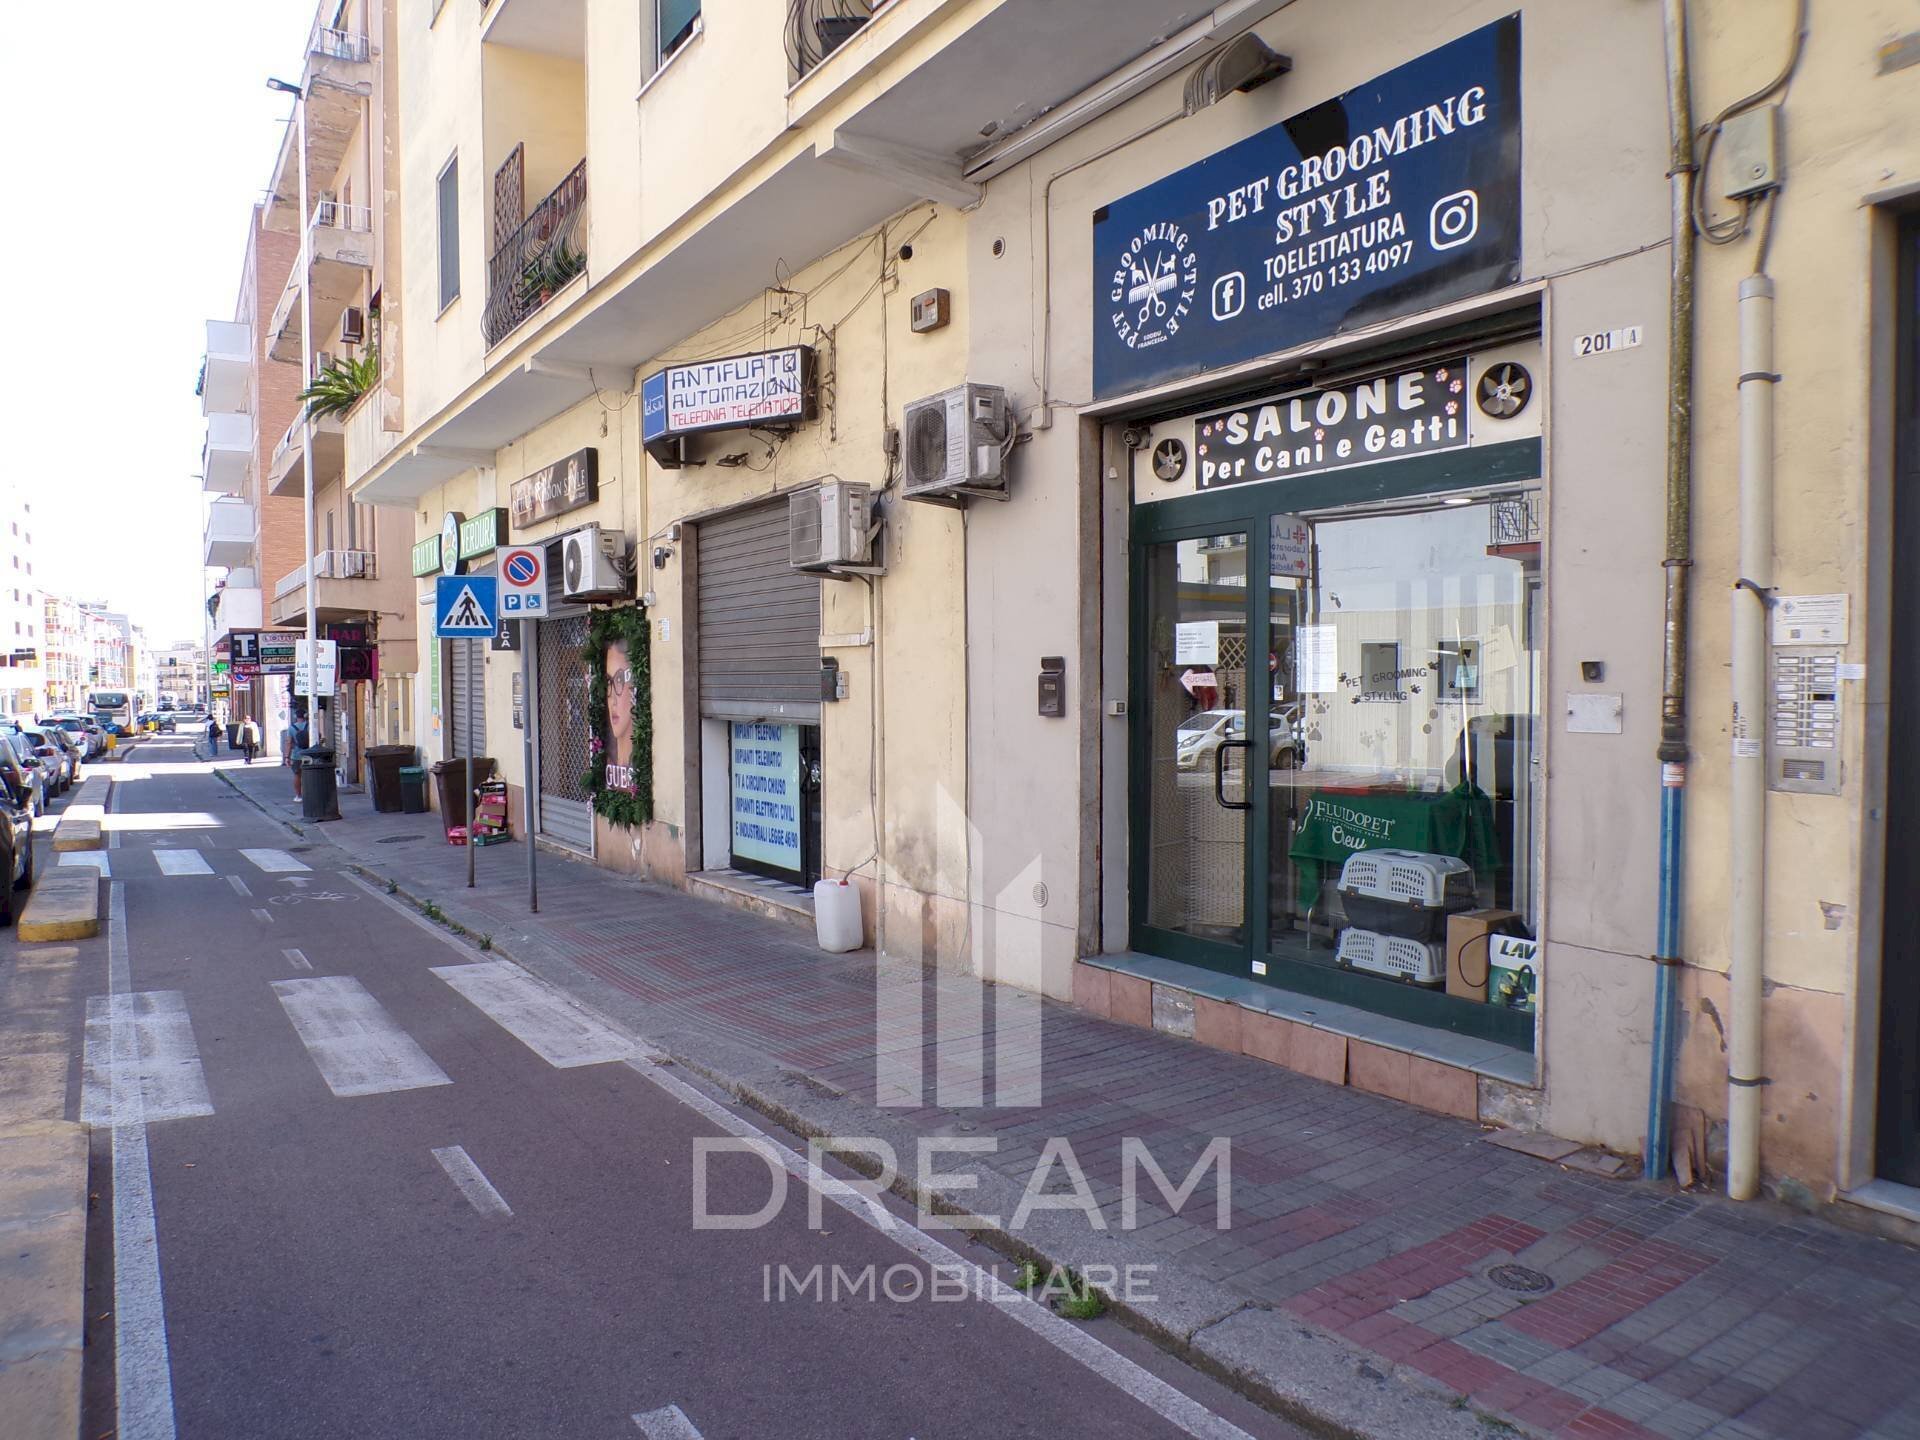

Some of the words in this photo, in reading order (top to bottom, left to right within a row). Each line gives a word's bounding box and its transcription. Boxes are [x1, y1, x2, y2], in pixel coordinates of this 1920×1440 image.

[1207, 177, 1269, 231] PET
[1276, 86, 1486, 201] GROOMING
[1275, 170, 1391, 244] STYLE
[1264, 212, 1405, 282] TOELETTATURA
[1111, 222, 1188, 302] GROOMING
[1258, 281, 1288, 310] cell.
[1292, 271, 1323, 300] 370
[1328, 264, 1360, 289] 133
[1365, 240, 1413, 274] 4097
[1166, 252, 1197, 335] STYLE
[1112, 310, 1139, 348] PET
[1137, 335, 1168, 349] FRANCESCA
[1582, 332, 1611, 355] 201
[1629, 329, 1637, 344] A
[672, 352, 796, 390] ANTIFURTO
[672, 378, 797, 410] AUTOMAZIONI
[1226, 372, 1425, 445] SALONE
[672, 407, 726, 426] TELEFONIA
[731, 397, 799, 419] TELEMATICA
[1202, 456, 1245, 486] per
[1255, 443, 1324, 473] Cani
[1337, 438, 1351, 458] e
[1365, 415, 1457, 453] Gatti
[414, 540, 439, 572] FRUTTA
[461, 516, 496, 554] VERDURA
[507, 596, 518, 608] P
[233, 634, 255, 657] T
[501, 619, 511, 648] ICA
[297, 661, 335, 670] Labtorio
[1346, 676, 1364, 688] PET
[1372, 667, 1427, 684] GROOMING
[1364, 691, 1408, 701] STYLING
[756, 749, 782, 767] TELEMATICI
[742, 775, 746, 789] A
[746, 775, 767, 792] CIRCUITO
[768, 778, 786, 795] CHIUSO
[735, 797, 755, 814] IMPIANTI
[756, 800, 780, 819] ELETTRICI
[781, 803, 795, 822] CIVILI
[1315, 800, 1394, 836] FLUIDOPET
[735, 821, 739, 836] E
[739, 822, 767, 842] INDUSTRIALI
[768, 828, 784, 846] LEGGE
[1500, 939, 1537, 960] LAV
